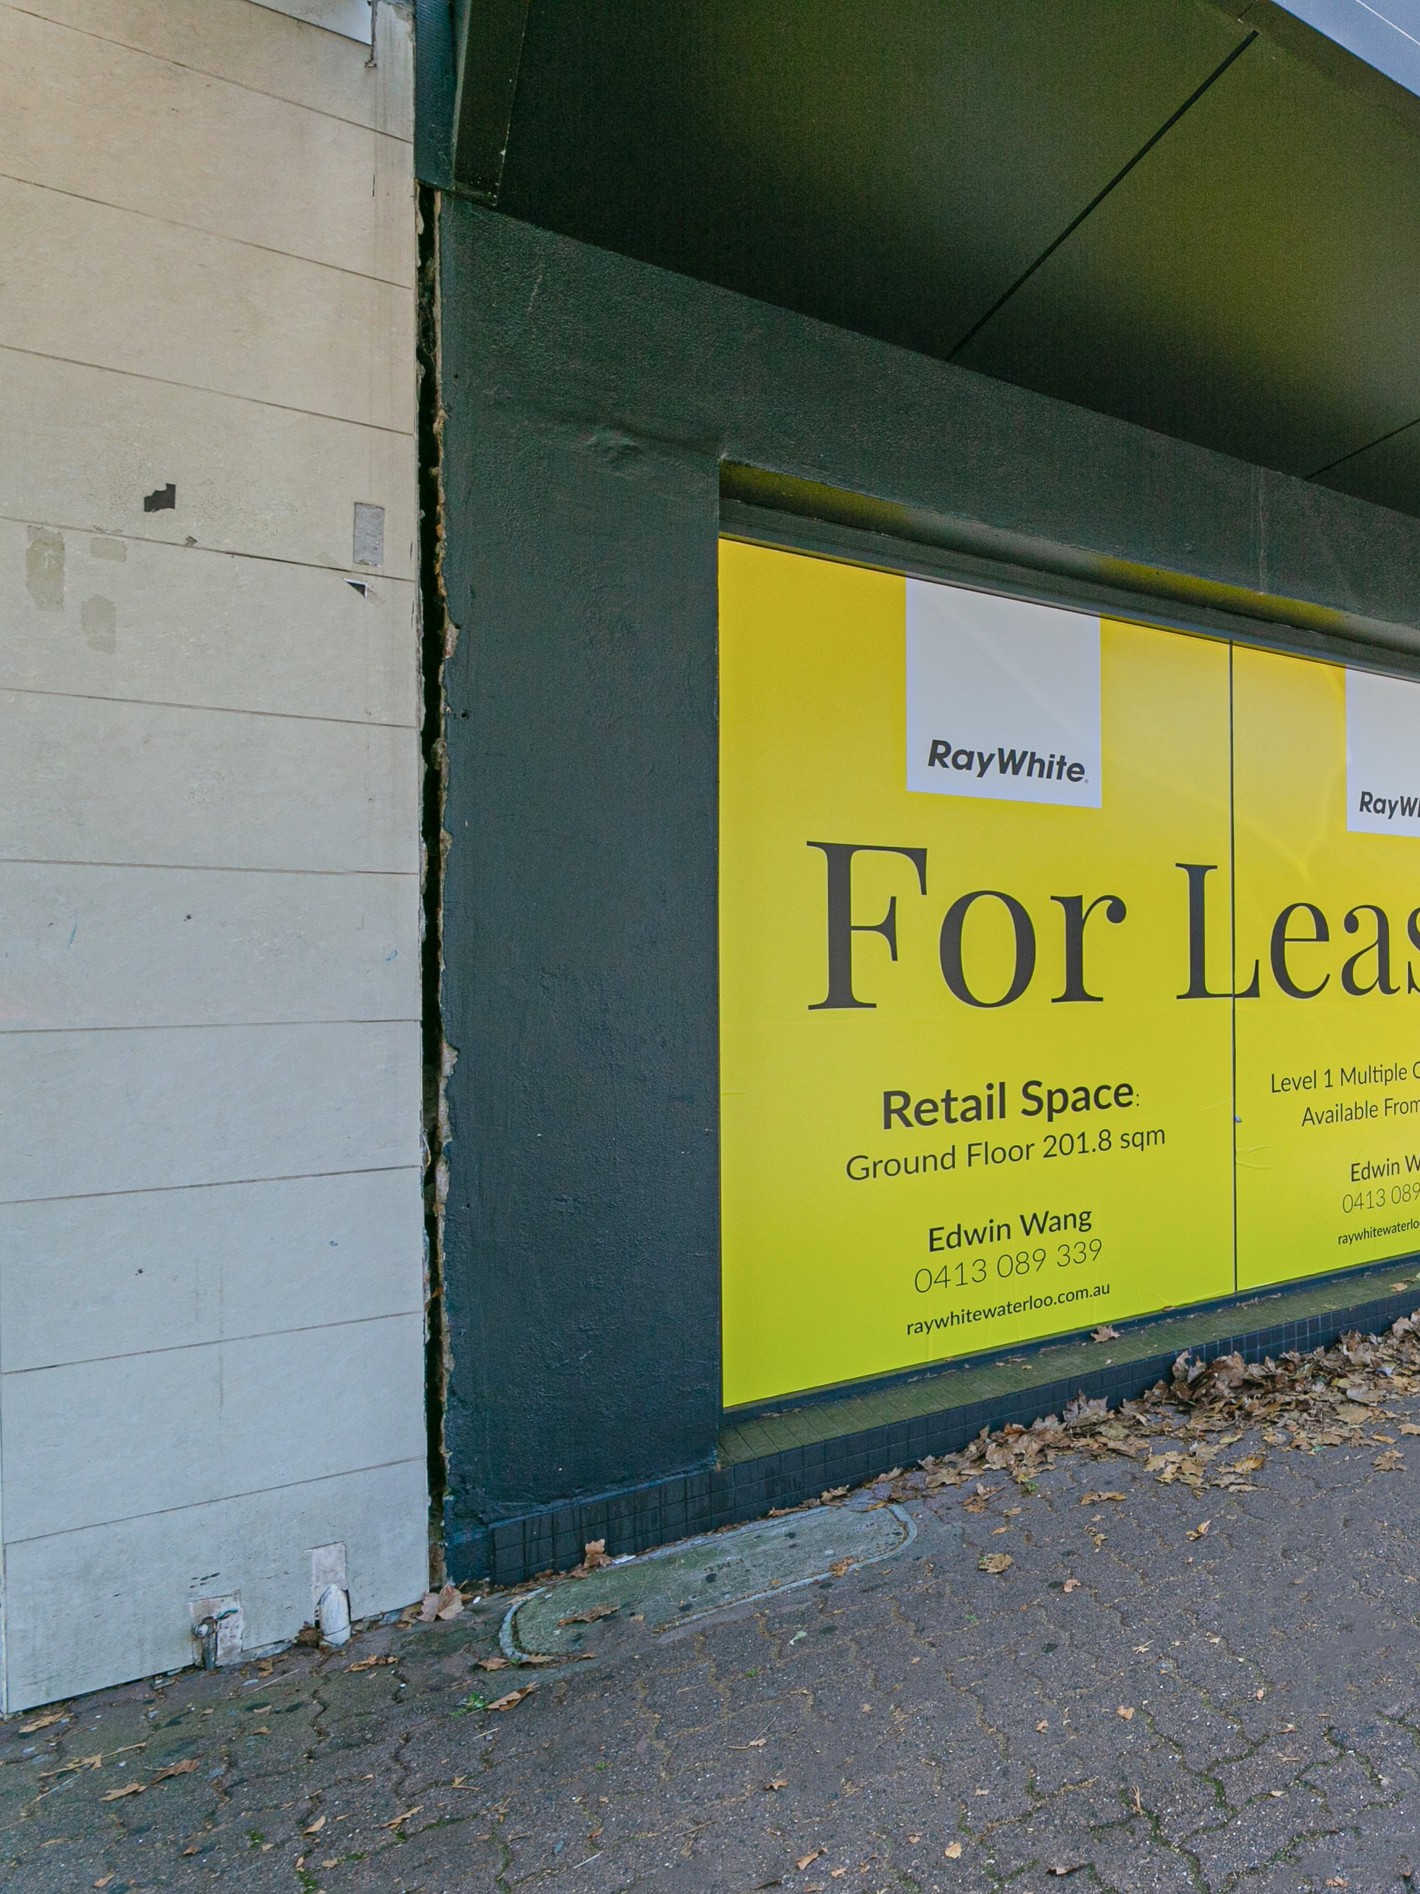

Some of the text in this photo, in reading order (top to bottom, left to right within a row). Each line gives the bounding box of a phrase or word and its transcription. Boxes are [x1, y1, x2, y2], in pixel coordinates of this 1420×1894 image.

[806, 840, 1128, 1012] For
[1270, 1069, 1317, 1094] Level
[1323, 1068, 1334, 1088] 1
[1340, 1062, 1408, 1087] Multiple
[882, 1081, 1006, 1130] Retail
[1301, 1100, 1379, 1127] Available
[846, 1128, 1166, 1181] Ground Floor 201.8 sqm
[1350, 1158, 1401, 1182] Edwin
[1342, 1188, 1386, 1214] 0413
[928, 1210, 1093, 1252] Edwin Wang
[914, 1238, 1103, 1294] 0413 089 339
[906, 1283, 1111, 1336] raywhitewaterloo.com.au
